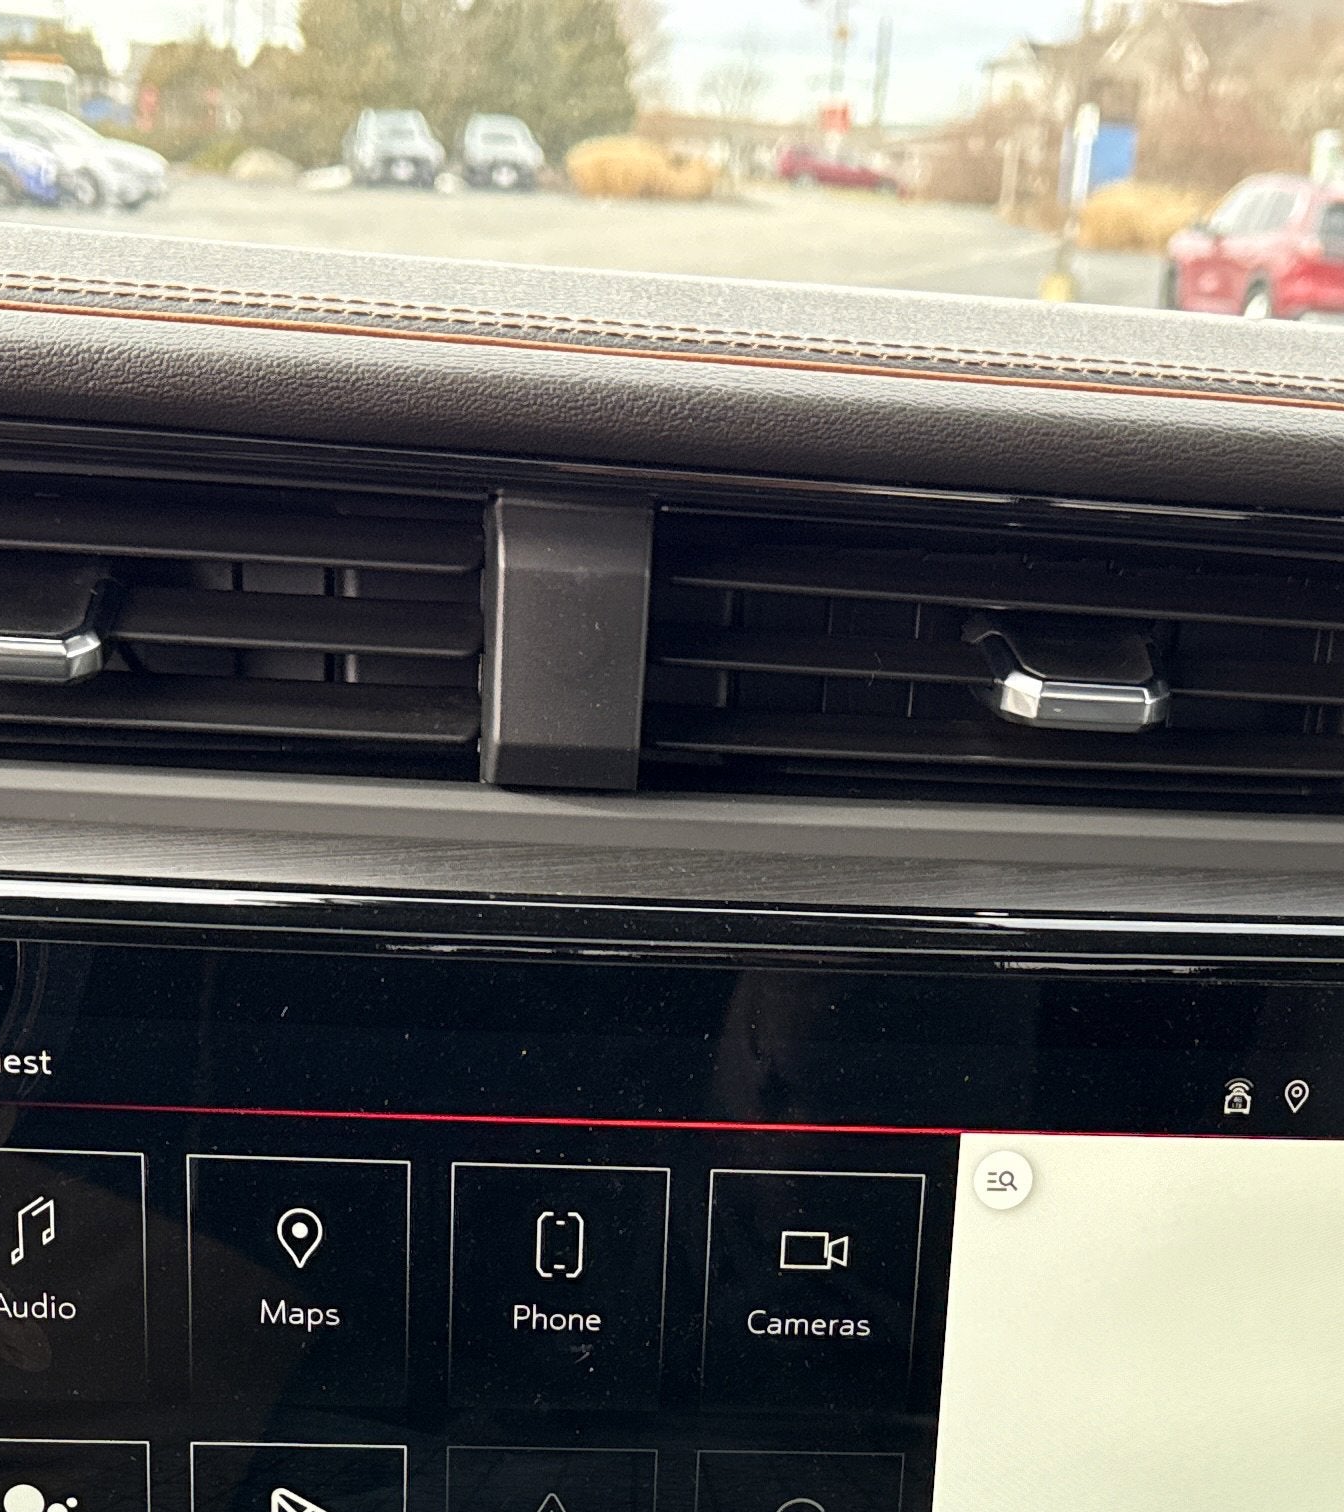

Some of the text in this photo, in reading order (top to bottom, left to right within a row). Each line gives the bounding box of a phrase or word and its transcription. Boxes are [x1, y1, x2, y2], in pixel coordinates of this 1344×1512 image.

[261, 1301, 340, 1332] Maps
[513, 1305, 602, 1333] Phone
[747, 1310, 871, 1338] Cameras
